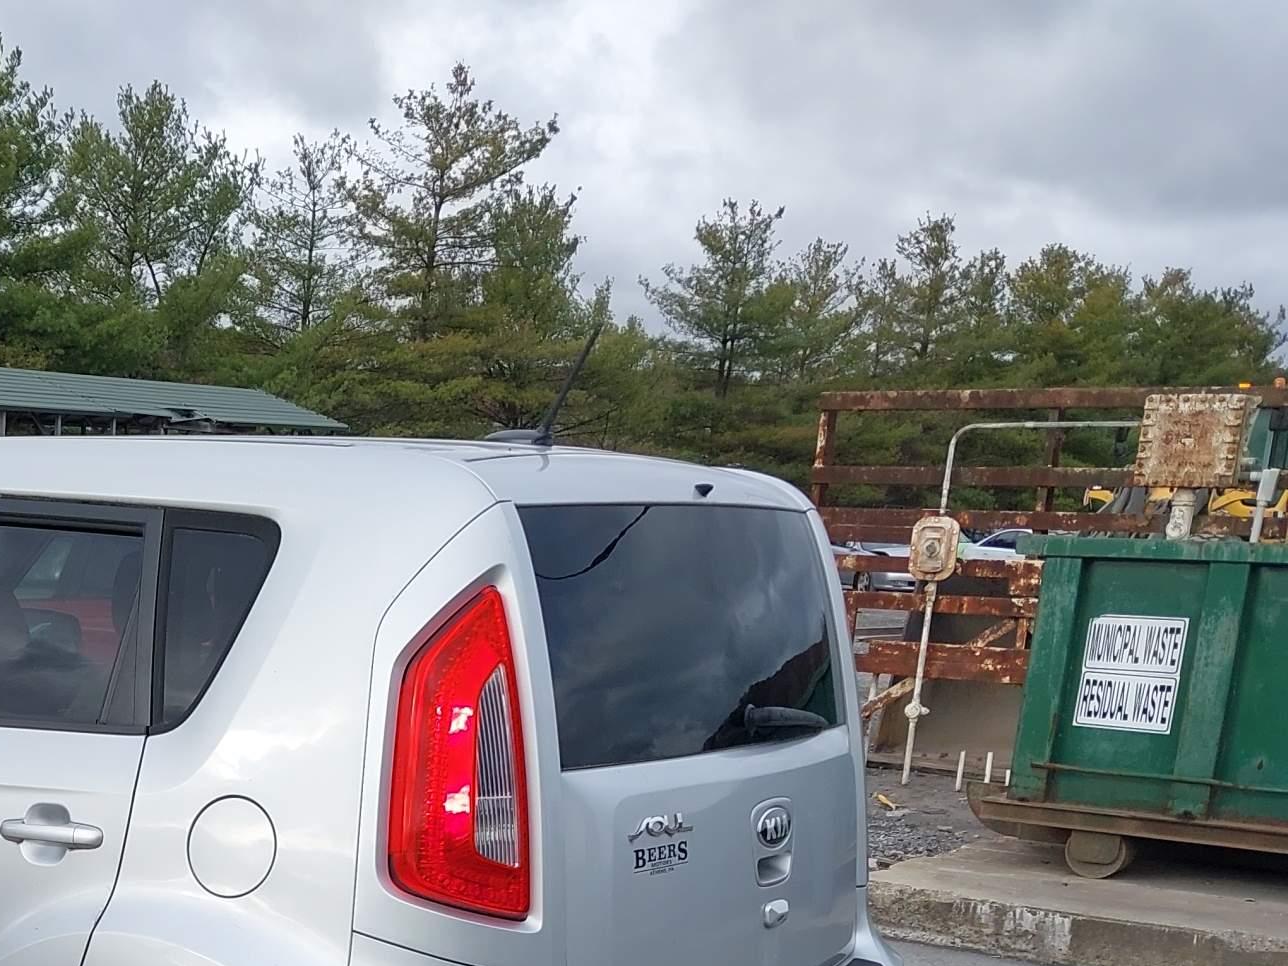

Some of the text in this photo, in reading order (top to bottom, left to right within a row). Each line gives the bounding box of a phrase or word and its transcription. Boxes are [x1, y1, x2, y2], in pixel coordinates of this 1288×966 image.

[1088, 623, 1182, 666] MUNICIPAL WASTE
[1079, 679, 1172, 725] RESIDUAL WASTE
[627, 812, 695, 844] SOUL
[765, 814, 789, 841] KIA
[633, 840, 689, 870] BEERS
